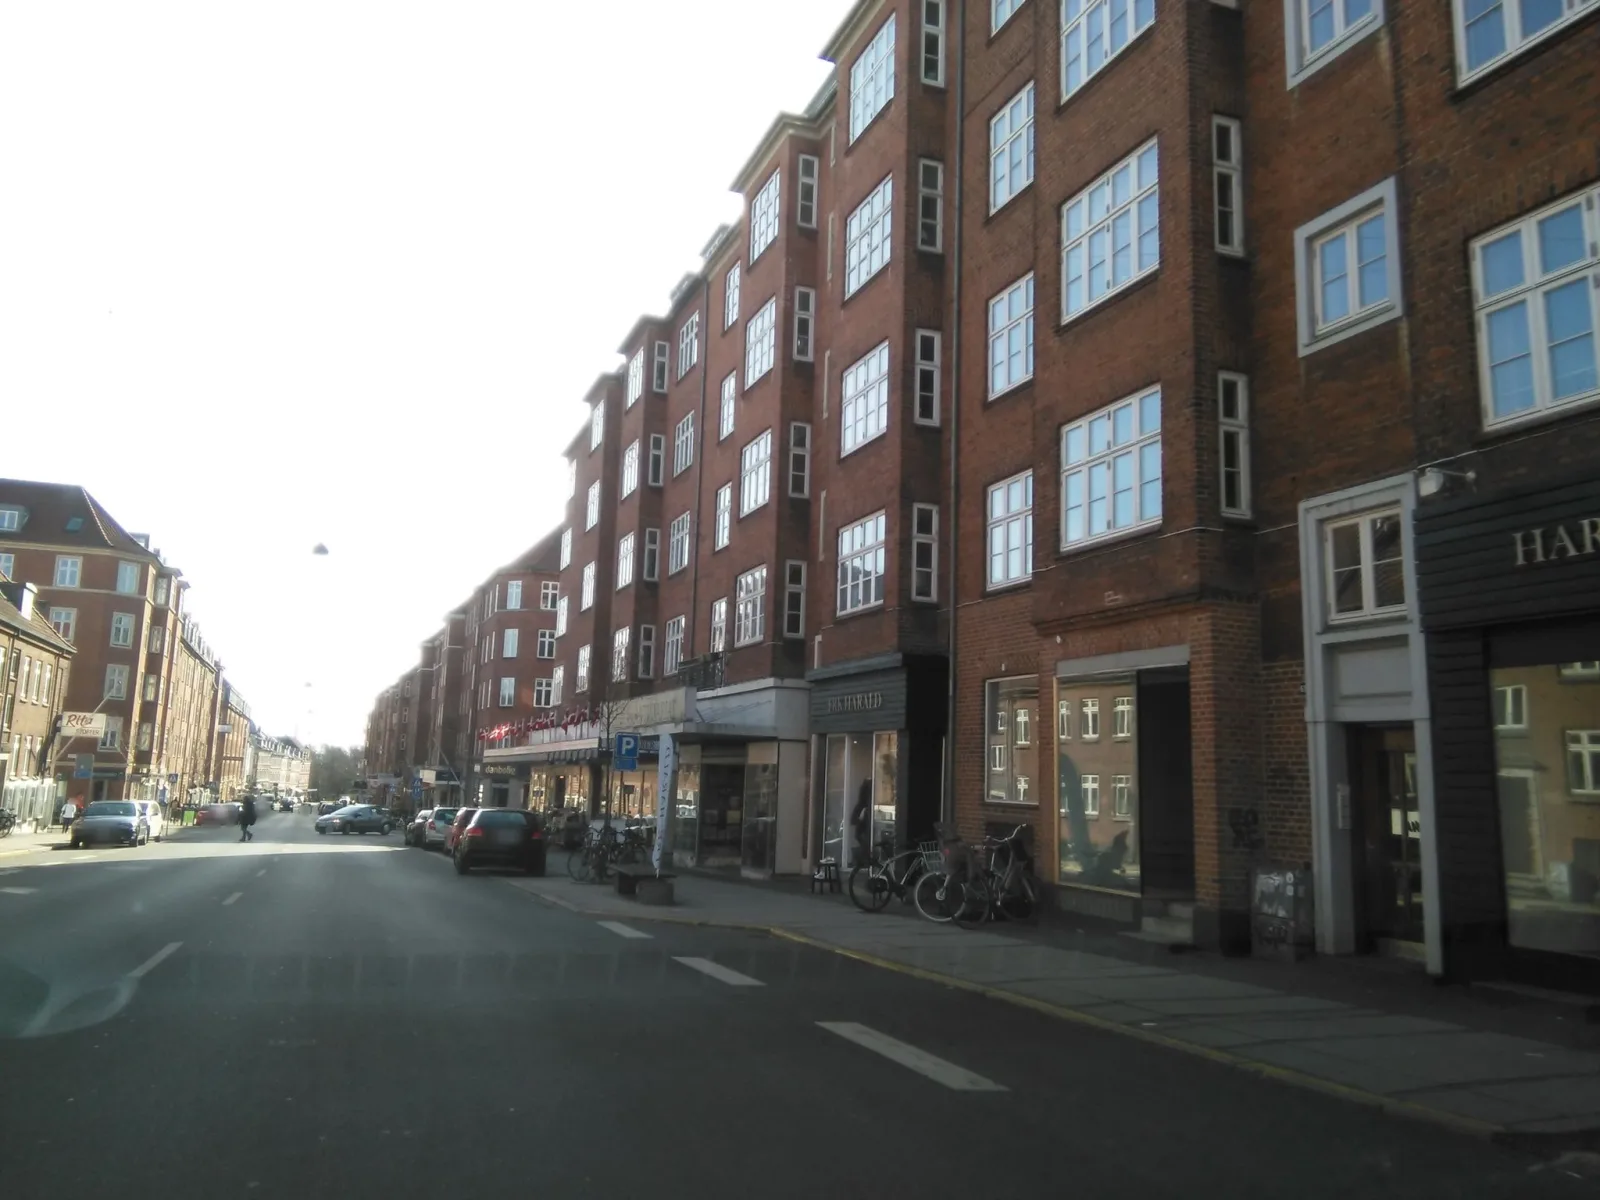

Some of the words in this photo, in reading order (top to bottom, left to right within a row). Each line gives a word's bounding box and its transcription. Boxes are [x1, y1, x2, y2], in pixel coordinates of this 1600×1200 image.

[844, 692, 882, 711] HARALD
[66, 714, 93, 727] Rita
[622, 737, 635, 755] P
